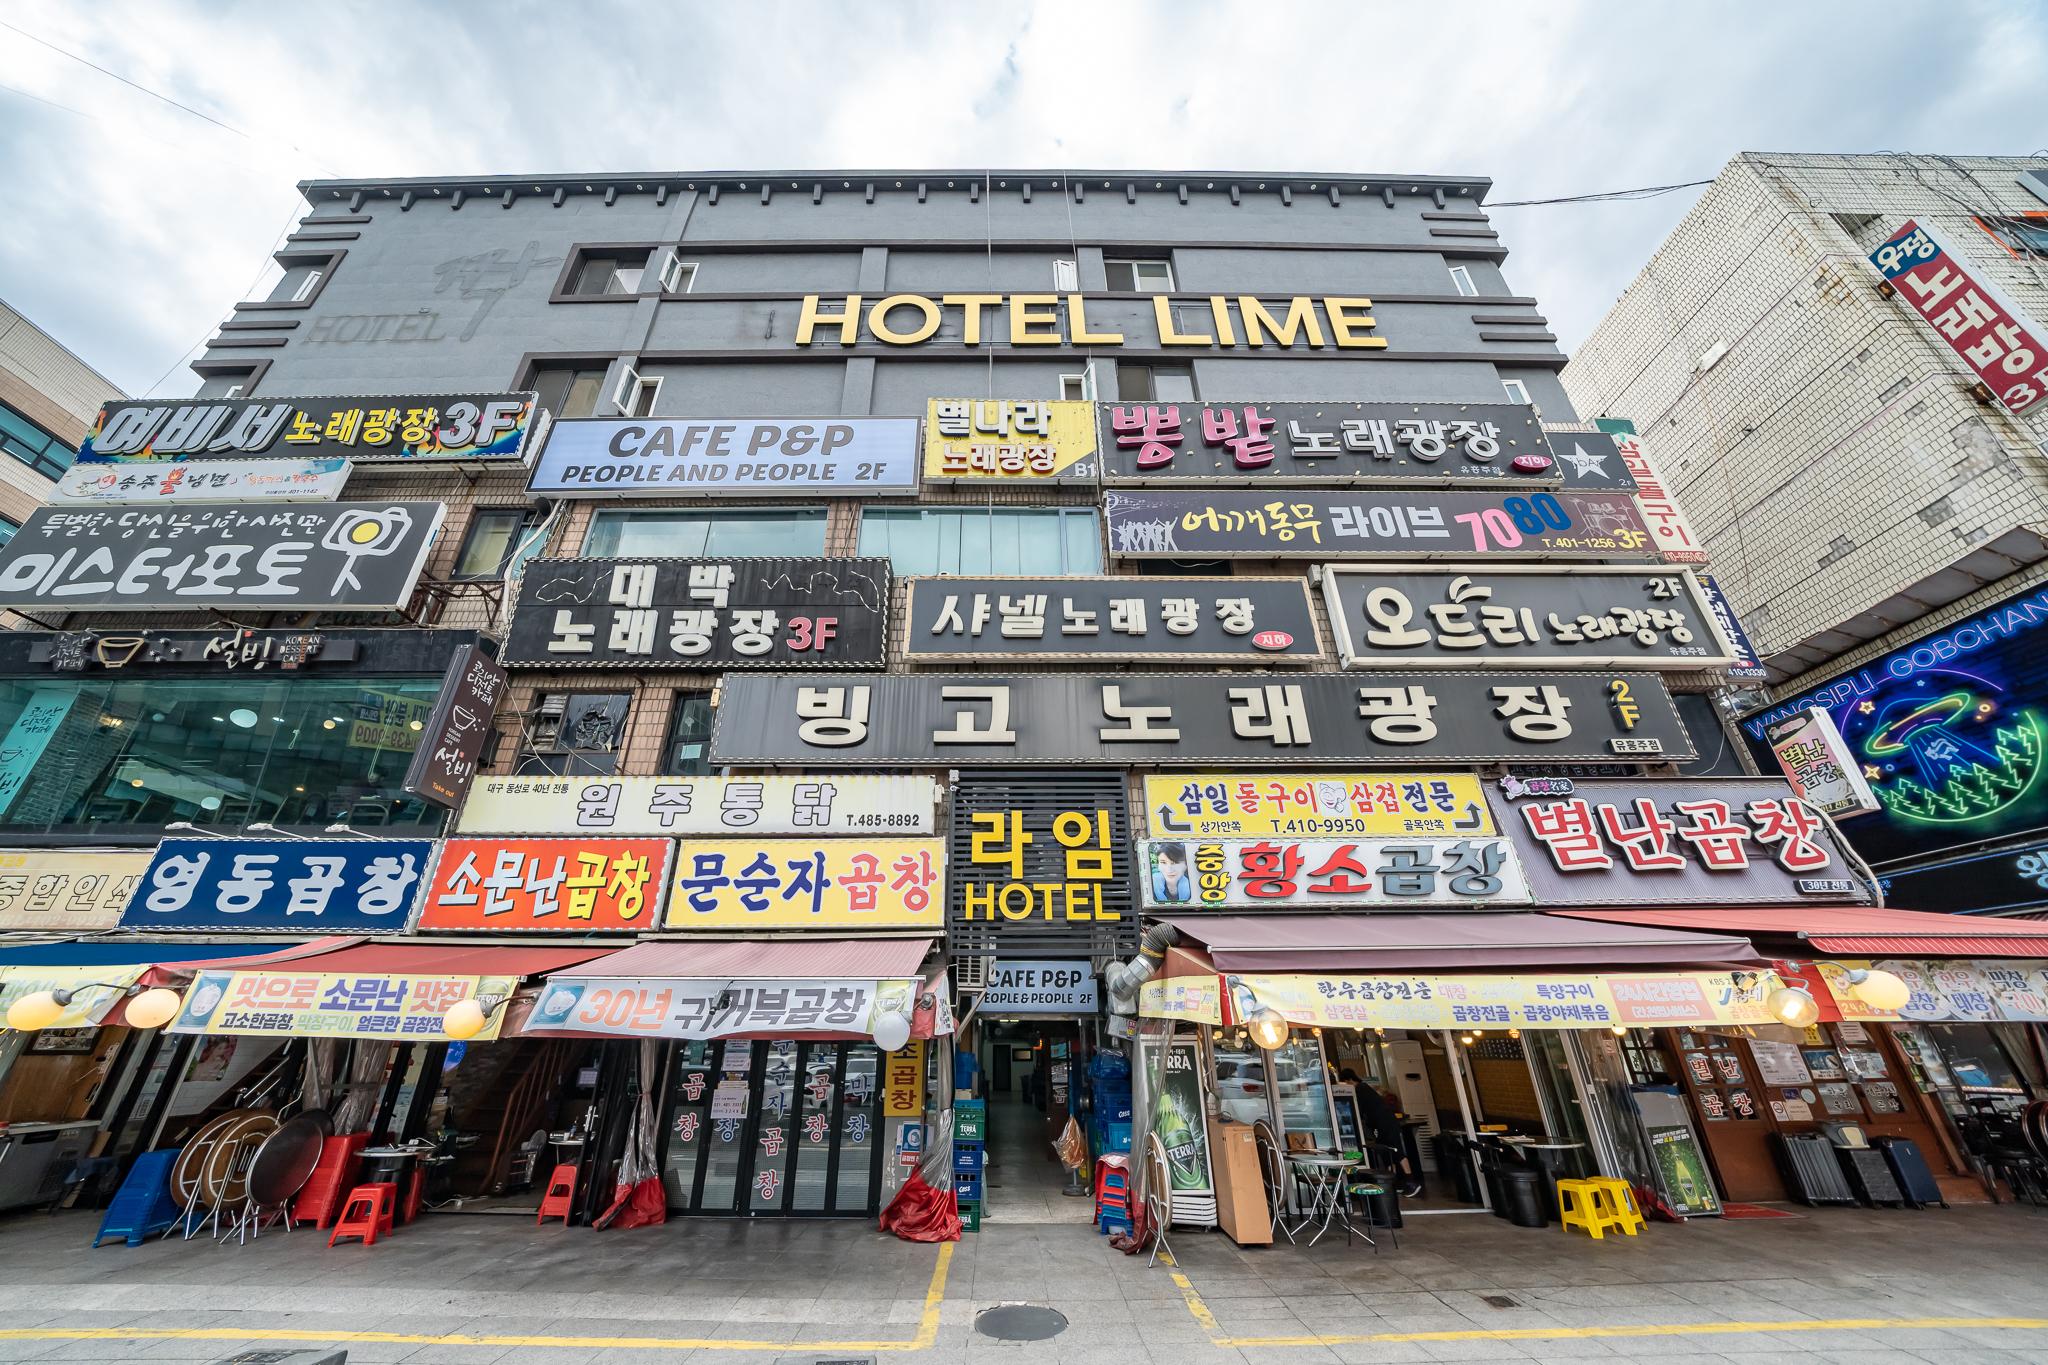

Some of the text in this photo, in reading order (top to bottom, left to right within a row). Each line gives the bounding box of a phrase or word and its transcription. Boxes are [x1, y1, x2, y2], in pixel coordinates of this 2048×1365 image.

[1877, 228, 1935, 273] 우정
[795, 294, 1389, 350] HOTEL LIME
[1904, 266, 2034, 374] 노래방
[91, 401, 525, 454] 여비서 노래광장 3F
[937, 400, 1052, 438] 별나라
[608, 424, 855, 458] CAFE P&P
[1287, 419, 1501, 463] 노래광장
[942, 443, 1057, 475] 노래광장
[1074, 461, 1095, 477] B1
[1460, 465, 1501, 475] 유흥주점
[1520, 455, 1546, 467] 지하
[560, 462, 887, 484] PEOPLE AND PEOPLE 2F
[42, 511, 114, 538] 특별한
[1181, 492, 1572, 553] 어깨동무 라이브 7080
[1541, 528, 1648, 549] T.401-1256 3F
[0, 542, 314, 597] 미스터포토
[608, 564, 736, 609] 대박
[1648, 578, 1684, 600] 2F
[1365, 576, 1541, 650] 오드리
[1548, 605, 1696, 648] 노래광장
[285, 635, 321, 645] KOREAN
[547, 609, 839, 656] 노래광장 3F
[1262, 634, 1287, 647] 지하
[203, 629, 273, 671] 설빙
[280, 644, 318, 655] DESSERT
[282, 653, 306, 664] CAFE
[1669, 645, 1708, 657] 유흥주점
[467, 672, 495, 695] 디저트
[473, 660, 501, 684] 코리안
[1727, 667, 1767, 678] 410-0330
[471, 684, 494, 707] 카페
[1610, 679, 1641, 731] 2F
[1615, 739, 1660, 753] 유흥주점
[1779, 738, 1828, 769] 별난
[434, 746, 473, 784] 설빙
[1794, 761, 1839, 790] 곱창
[431, 781, 445, 792] Take
[487, 783, 569, 794] 대구 동성로 40년 전통
[576, 782, 920, 827] 원주통닭 T.485-8892
[1200, 820, 1242, 833] 상가안쪽
[1270, 818, 1366, 834] T.410-9950
[1403, 817, 1445, 832] 골목안쪽
[1519, 797, 1833, 873] 별난곱창
[971, 809, 1113, 880] 라임
[145, 851, 419, 916] 영동곱창
[1194, 843, 1232, 902] 중앙
[1807, 880, 1829, 891] 30년
[965, 882, 1121, 921] HOTEL
[987, 969, 1083, 988] CAFE P&P
[228, 976, 471, 1015] 맛으로 소문난 맛집
[985, 992, 1020, 1004] EOPLE
[1031, 992, 1074, 1004] PEOPLE
[1080, 992, 1093, 1004] 2F
[1536, 984, 1595, 1000] 특양구이
[579, 987, 672, 1030] 30년
[1452, 1004, 1511, 1022] 곱창전골
[1523, 1004, 1610, 1022] 곱창야채볶음
[356, 1014, 401, 1034] 얼큰한
[401, 1015, 444, 1035] 곱창전
[1150, 1054, 1193, 1071] TRRA
[674, 1072, 706, 1142] 곱창
[804, 1072, 831, 1143] 곱창
[846, 1072, 872, 1143] 막창
[1117, 1110, 1131, 1119] Cass
[959, 1124, 977, 1135] TERRA
[1167, 1143, 1196, 1162] TERRA
[958, 1214, 973, 1226] ERRA
